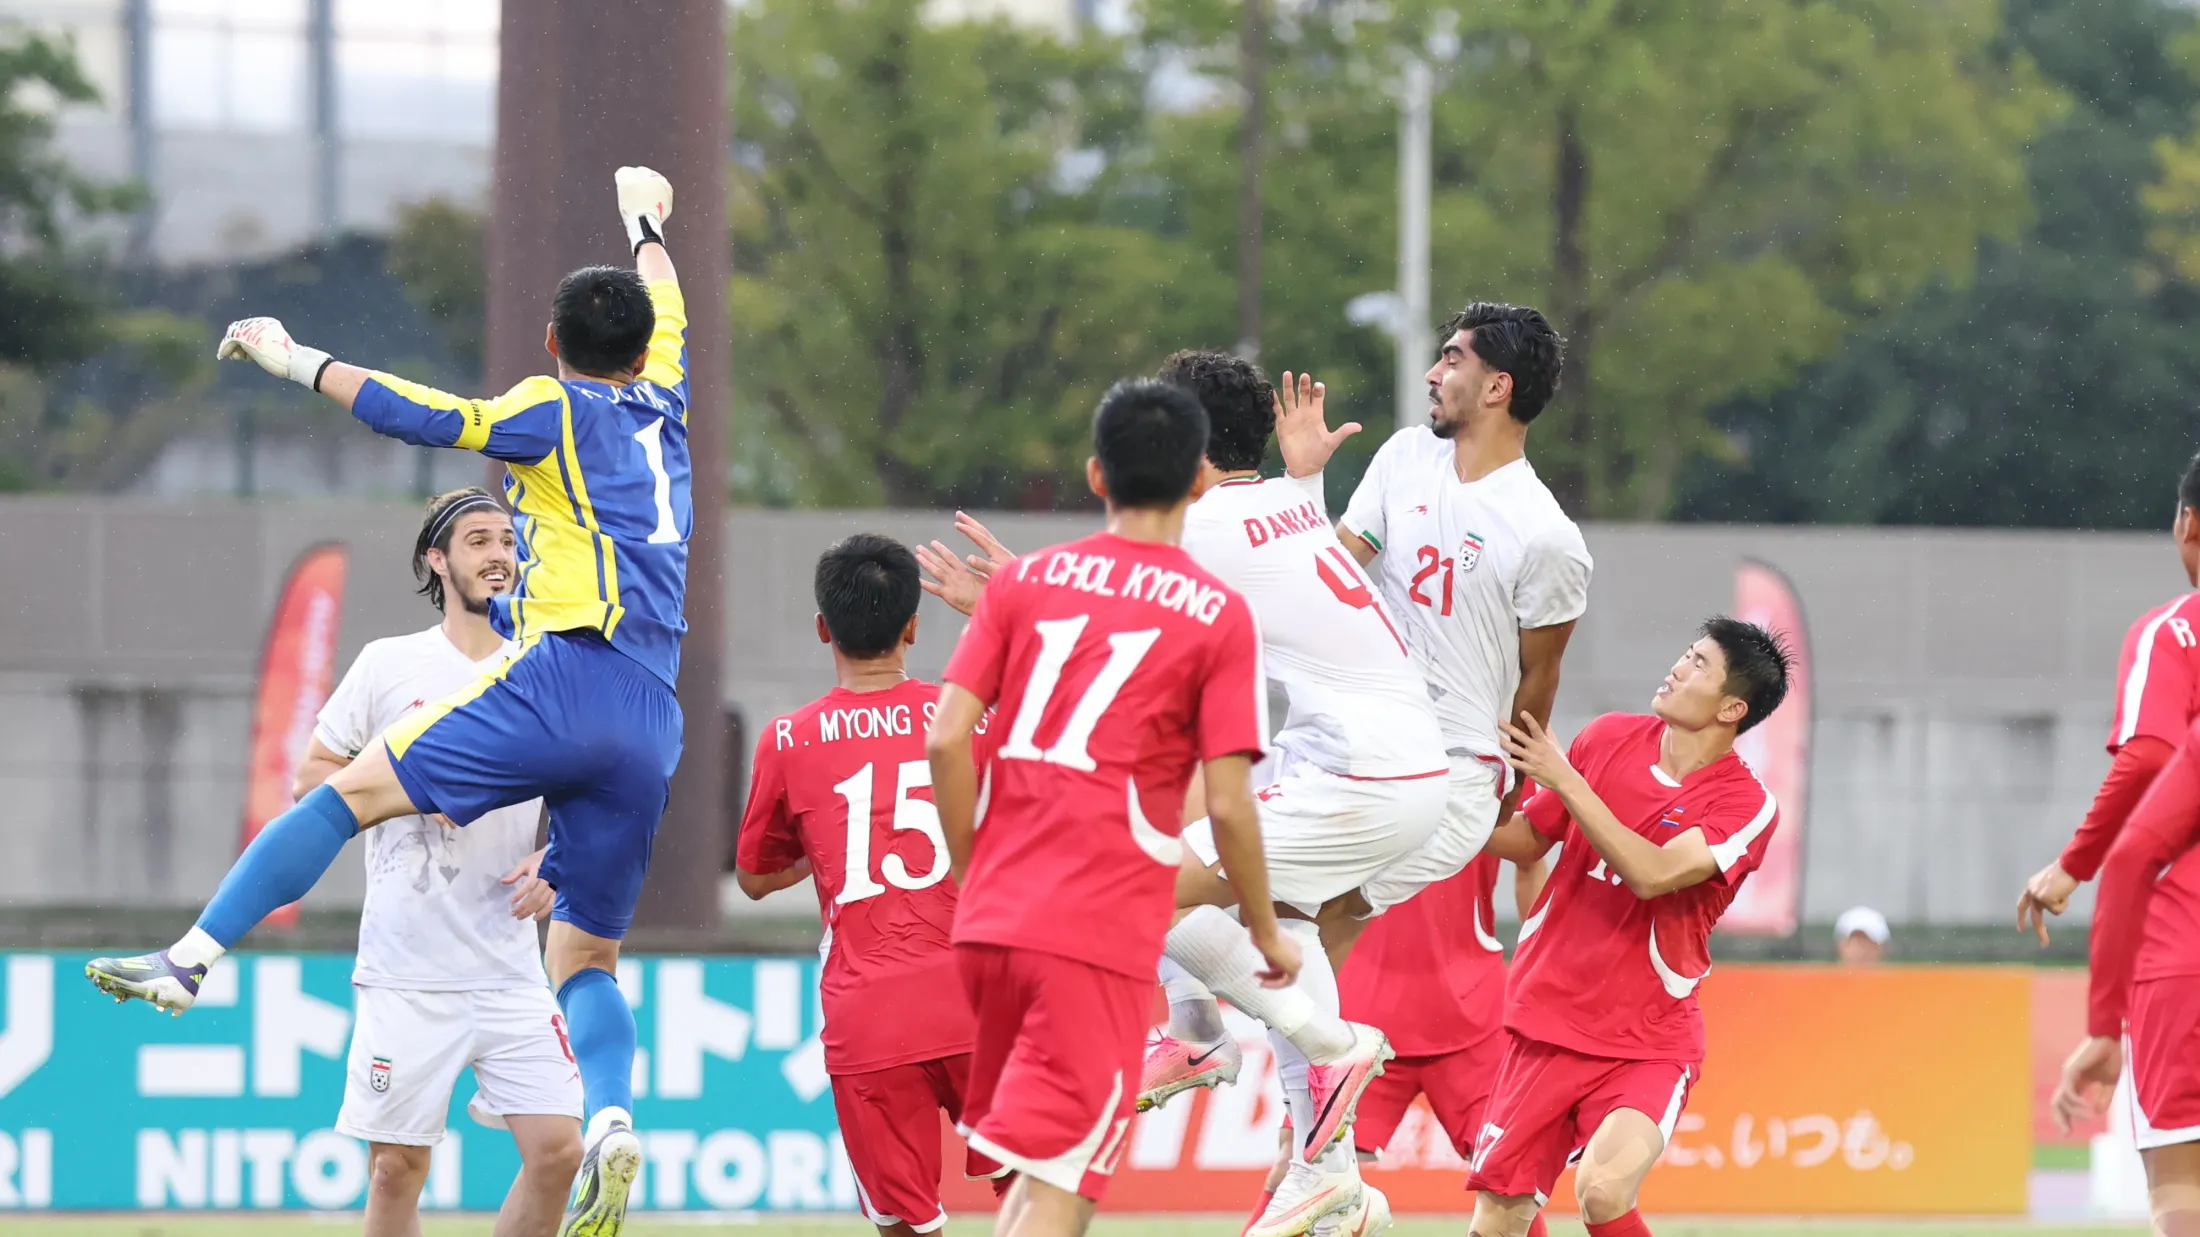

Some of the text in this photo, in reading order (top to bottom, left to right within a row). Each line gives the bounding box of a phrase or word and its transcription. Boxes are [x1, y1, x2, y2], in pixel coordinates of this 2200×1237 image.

[634, 415, 681, 544] 1
[1043, 551, 1116, 597] CHOL
[1120, 563, 1227, 627] KYONG
[1314, 546, 1408, 658] 4
[1409, 545, 1454, 617] 21
[819, 704, 912, 743] MYONG
[998, 613, 1161, 773] 11
[834, 760, 951, 906] 15
